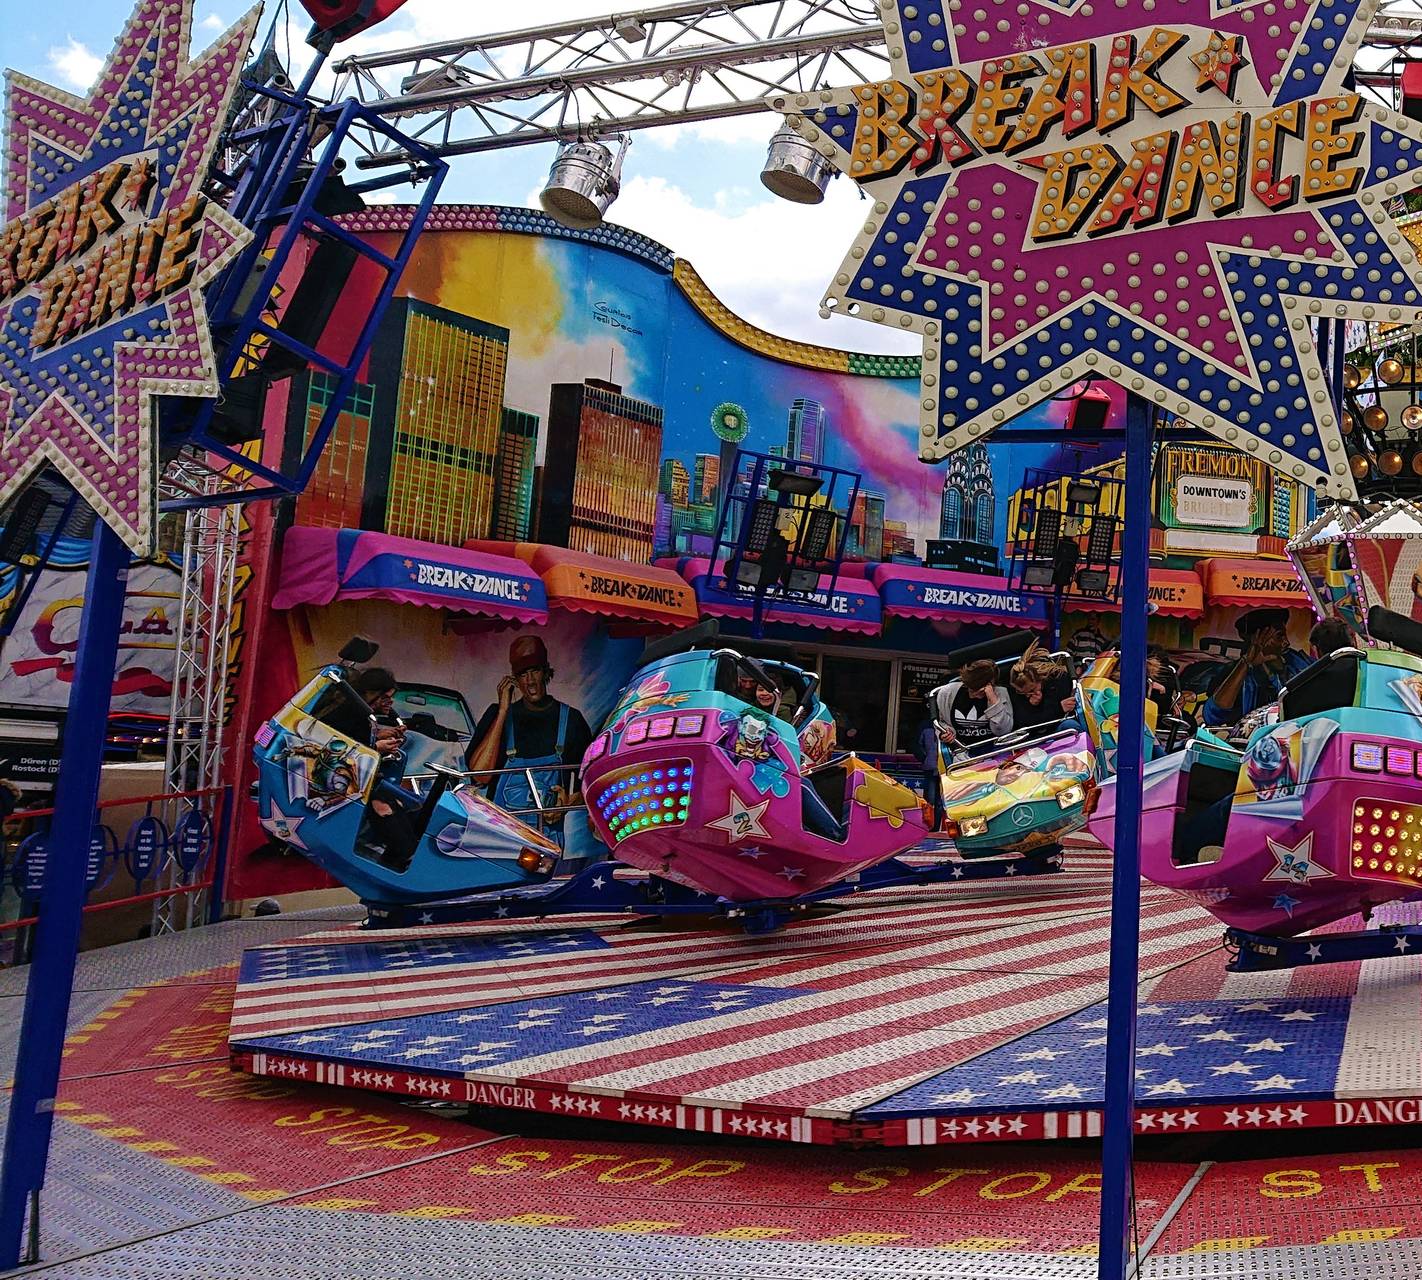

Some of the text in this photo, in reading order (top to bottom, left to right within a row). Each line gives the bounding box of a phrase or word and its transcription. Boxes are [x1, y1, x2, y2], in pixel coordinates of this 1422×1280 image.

[848, 26, 1189, 181] BREAK
[1017, 92, 1367, 244] DANCE
[29, 192, 208, 350] DANCE
[1167, 449, 1265, 492] FREMONT
[1183, 485, 1247, 501] DOWNTOWN'S
[418, 563, 521, 601] BREAK DANCE
[590, 575, 675, 608] BREAK DANCE
[1241, 576, 1283, 592] BREAK
[923, 587, 1021, 612] BREAK DANCE
[12, 765, 46, 773] Rostock
[20, 757, 47, 766] Düren
[733, 811, 753, 835] 2
[465, 1081, 536, 1110] DANGER
[273, 1107, 442, 1152] STOP
[468, 1150, 746, 1186] STOP
[828, 1166, 1103, 1203] STOP
